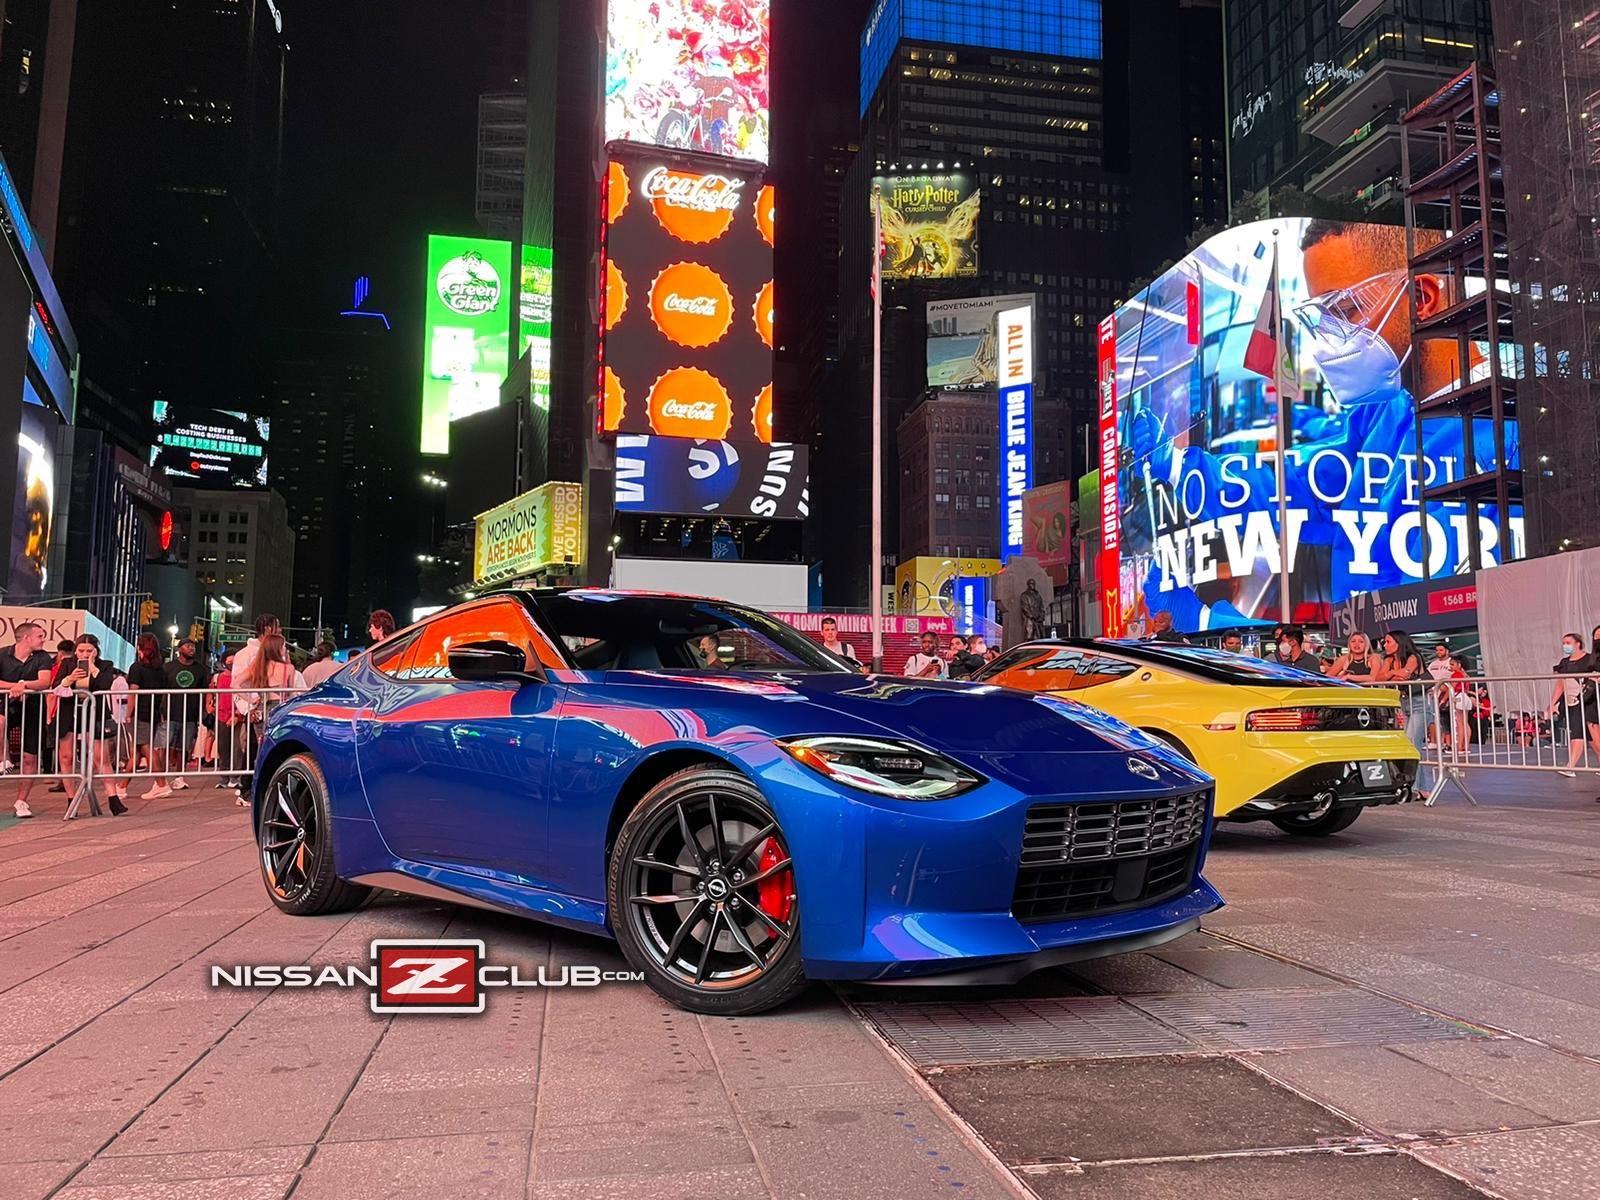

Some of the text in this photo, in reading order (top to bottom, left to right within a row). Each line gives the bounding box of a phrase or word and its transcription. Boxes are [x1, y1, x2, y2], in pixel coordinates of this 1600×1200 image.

[891, 184, 960, 209] Harry Potter
[448, 283, 497, 297] Green
[450, 294, 499, 313] Giant
[929, 301, 994, 311] #MOVETOMIAMI
[1007, 324, 1025, 378] ALL IN
[176, 428, 247, 443] COSTING BUSINESSES
[190, 423, 207, 431] TECH
[208, 425, 226, 433] DEBT
[1007, 390, 1026, 447] BILLIE
[1102, 426, 1116, 480] COME
[1007, 450, 1027, 497] JEAN
[1103, 482, 1118, 551] INSIDE!
[1156, 468, 1206, 530] NO
[487, 505, 537, 545] MORMONS
[553, 486, 566, 559] WE MISSED
[564, 487, 579, 556] YOU TOO!
[487, 541, 505, 567] ARE
[507, 529, 537, 559] BACK!
[1158, 508, 1308, 593] NEW
[1373, 598, 1419, 623] BROADWAY
[1443, 595, 1463, 607] 1568
[1367, 765, 1385, 780] Z
